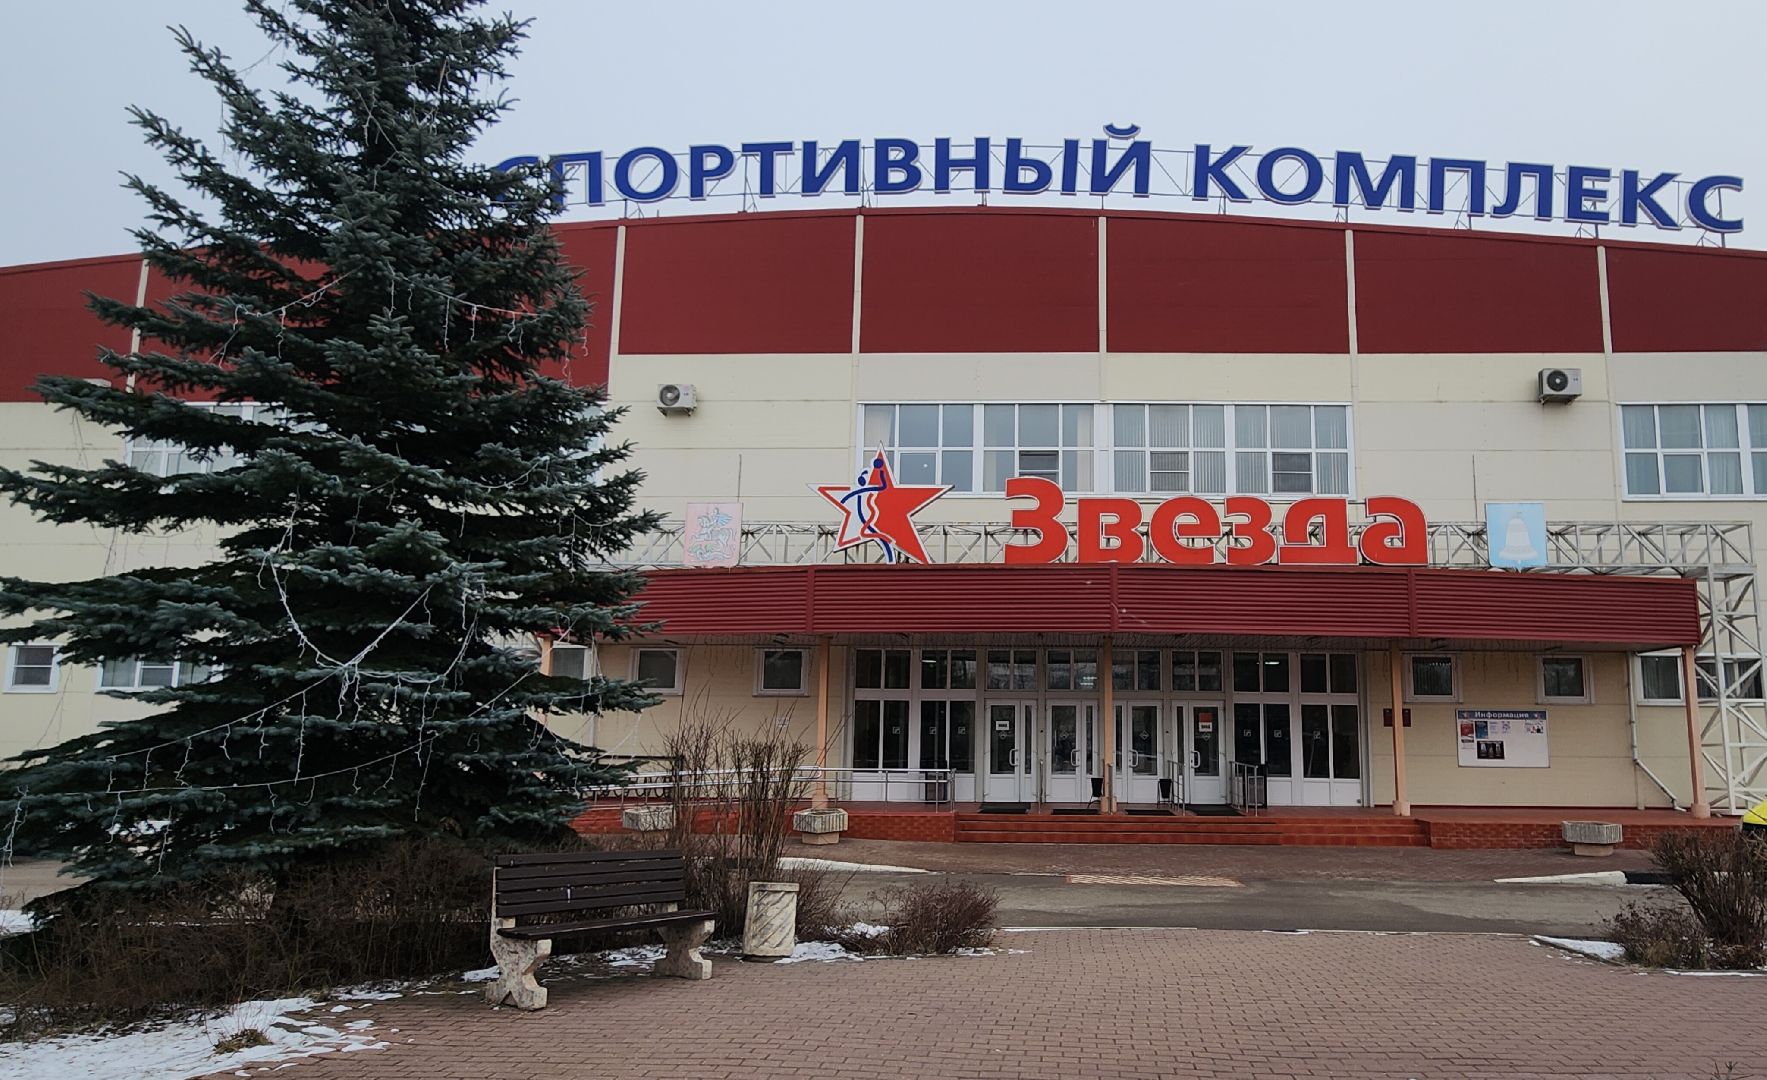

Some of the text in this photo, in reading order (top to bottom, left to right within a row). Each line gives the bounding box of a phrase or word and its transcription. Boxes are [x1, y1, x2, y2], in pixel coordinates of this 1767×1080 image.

[1192, 144, 1744, 233] КОМПЛЕКС
[1005, 476, 1428, 566] Звезда
[1474, 710, 1529, 719] Информация
